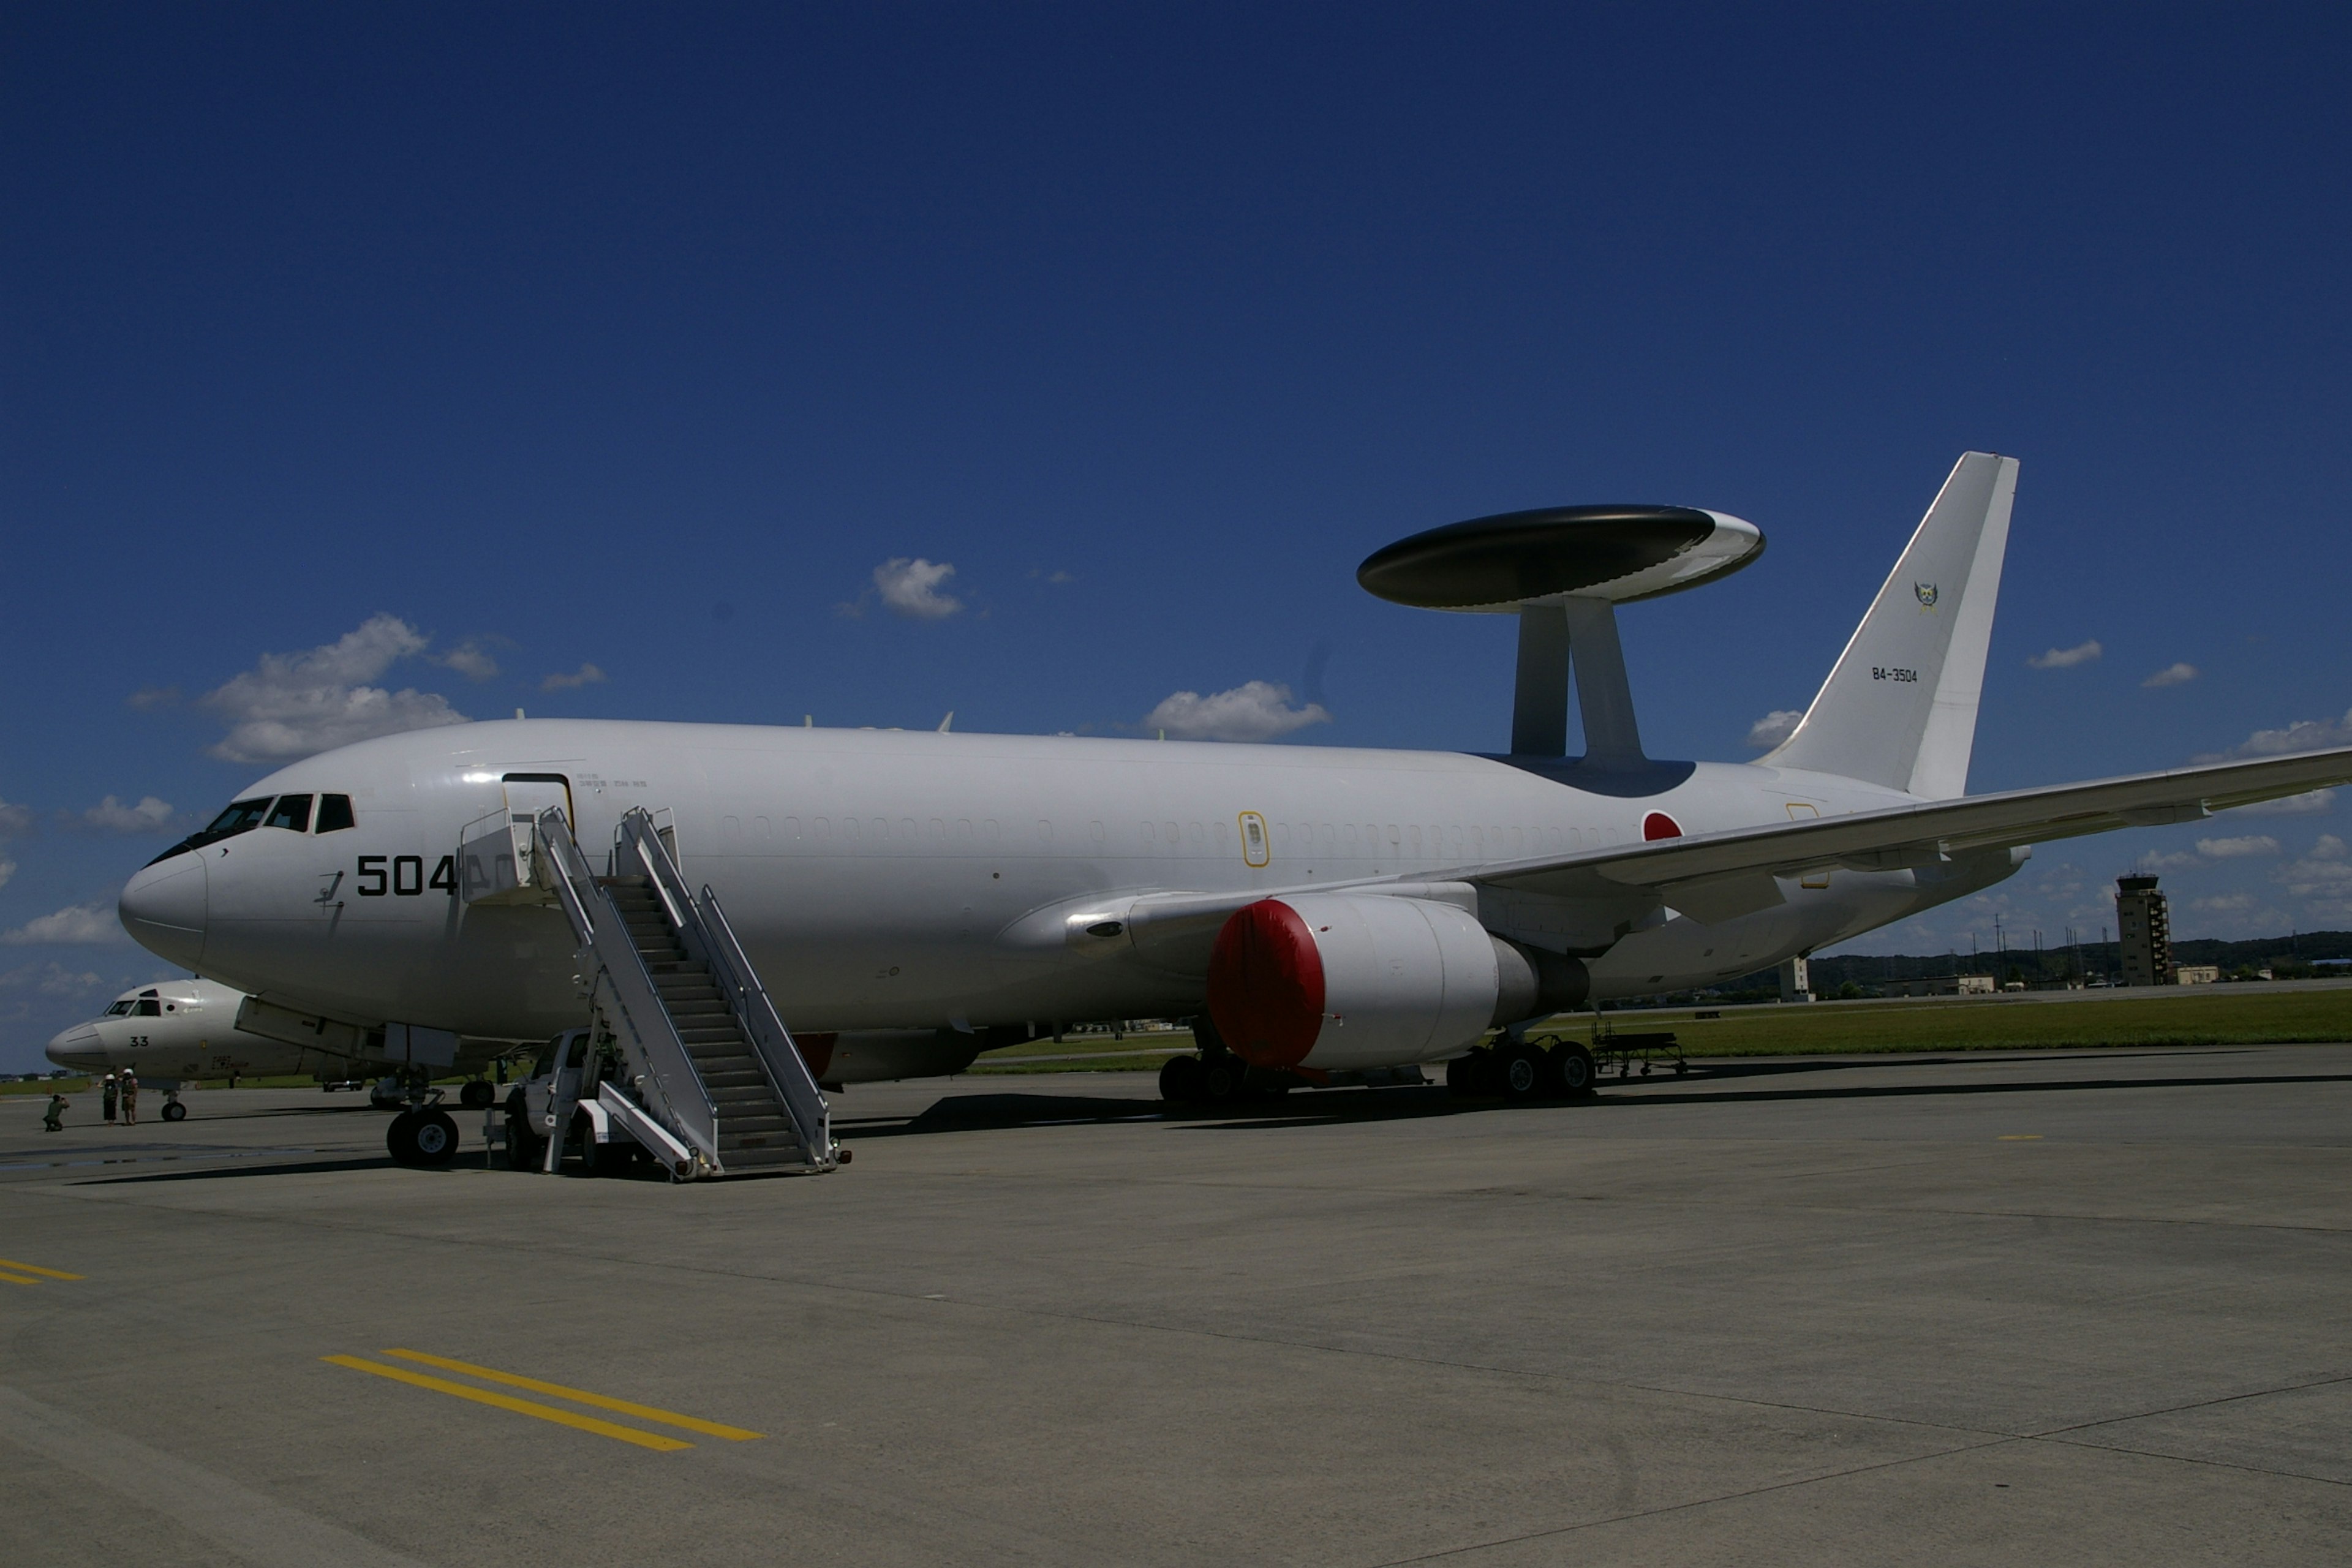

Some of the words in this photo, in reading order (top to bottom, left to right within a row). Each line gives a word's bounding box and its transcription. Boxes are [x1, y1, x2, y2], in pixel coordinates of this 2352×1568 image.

[1872, 667, 1917, 683] 84-3504
[358, 855, 458, 896] 504
[130, 1036, 149, 1047] 33
